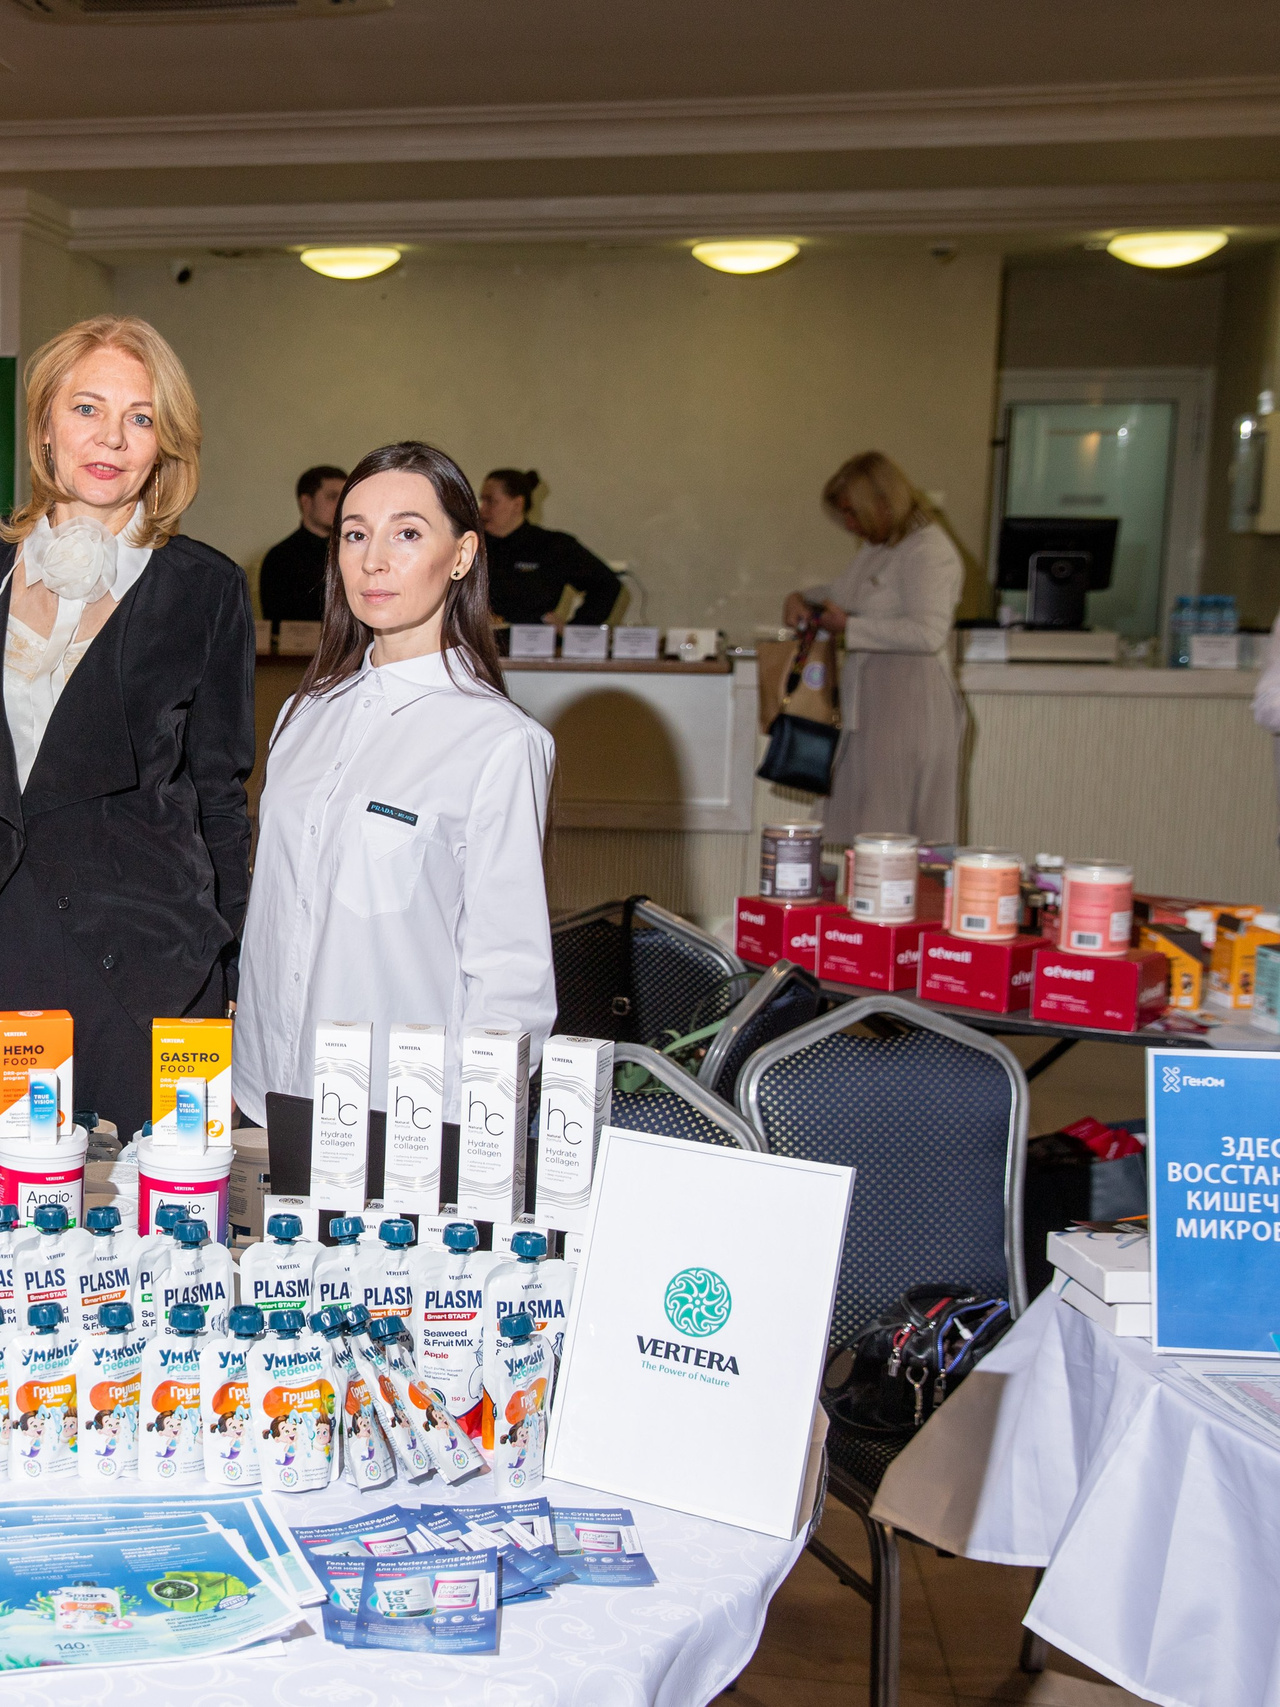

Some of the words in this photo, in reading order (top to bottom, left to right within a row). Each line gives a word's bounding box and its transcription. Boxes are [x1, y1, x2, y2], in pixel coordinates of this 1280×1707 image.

[371, 804, 394, 815] PRADA
[4, 1045, 44, 1056] HEMO
[4, 1057, 38, 1066] FOOD
[160, 1052, 220, 1063] GASTRO
[160, 1065, 195, 1073] FOOD
[1182, 1075, 1225, 1088] ГенОм
[320, 1131, 352, 1139] Hydrate
[394, 1134, 426, 1143] Hydrate
[320, 1139, 355, 1147] collagen
[394, 1142, 429, 1151] collagen
[467, 1139, 499, 1149] Hydrate
[467, 1148, 502, 1157] collagen
[546, 1147, 577, 1158] Hydrate
[545, 1157, 579, 1167] collagen
[1187, 1190, 1280, 1214] КИШЕЧ
[96, 1254, 118, 1262] VERTERA
[80, 1268, 130, 1293] PLASM
[448, 1273, 473, 1281] VERTERA
[254, 1278, 310, 1299] PLASM
[101, 1292, 122, 1302] START
[164, 1282, 226, 1307] PLASMA
[425, 1290, 483, 1309] PLASM
[391, 1309, 410, 1317] START
[496, 1300, 565, 1319] PLASMA
[423, 1329, 468, 1337] Seaweed
[423, 1339, 431, 1347] &
[432, 1339, 454, 1347] Fruit
[455, 1339, 474, 1347] MIX
[21, 1339, 80, 1367] Умный
[93, 1337, 148, 1366] Умный
[424, 1350, 449, 1359] Apple
[637, 1335, 739, 1376] VERTERA
[263, 1346, 323, 1370] Умный
[272, 1362, 323, 1379] ребенок
[641, 1360, 657, 1371] The
[659, 1364, 686, 1378] Power
[688, 1371, 699, 1381] of
[699, 1373, 730, 1388] Nature
[33, 1383, 71, 1400] Груша
[109, 1383, 141, 1400] Груша
[283, 1390, 320, 1406] Груша
[342, 1526, 373, 1536] качества
[374, 1518, 400, 1529] жизни!
[420, 1562, 457, 1570] качества
[459, 1558, 488, 1567] жизни!
[382, 1588, 413, 1596] ver
